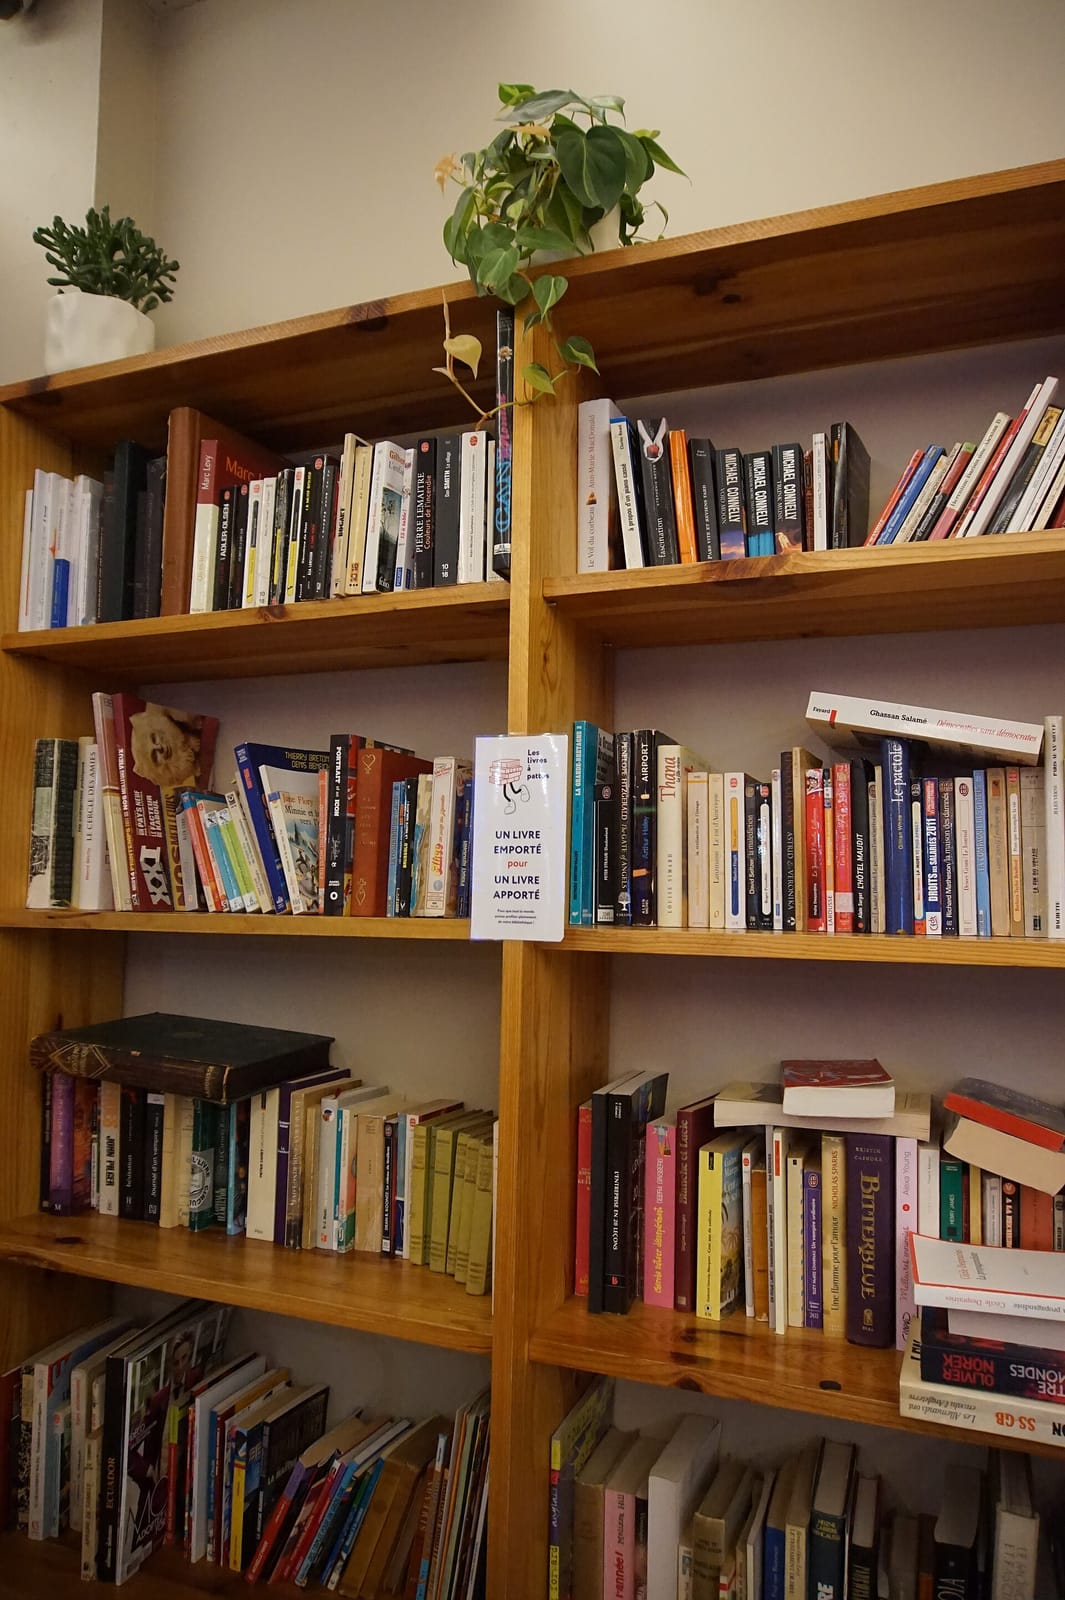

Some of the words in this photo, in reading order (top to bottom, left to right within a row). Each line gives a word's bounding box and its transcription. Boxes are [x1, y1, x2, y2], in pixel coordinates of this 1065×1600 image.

[203, 455, 213, 471] Levy
[725, 454, 737, 485] MICHAEL
[753, 457, 766, 489] MICHAEL
[783, 450, 795, 482] MICHAEL
[202, 472, 210, 489] Marc
[416, 473, 425, 518] LEMAITRE
[727, 487, 740, 522] CONNELLY
[784, 484, 797, 520] CONNELLY
[425, 509, 431, 518] de
[626, 508, 634, 526] propos
[755, 490, 768, 525] CONNELLY
[416, 520, 424, 552] PIERRE
[589, 536, 594, 545] du
[656, 518, 667, 558] fascination
[589, 560, 594, 568] Le
[378, 576, 392, 590] folio
[870, 709, 900, 720] Ghassan
[901, 715, 928, 724] Salamé
[997, 728, 1038, 743] démocrates
[285, 752, 307, 760] THIERRY
[527, 756, 548, 764] livres
[641, 742, 649, 782] AIRPORT
[889, 743, 906, 786] pactole
[527, 773, 550, 781] patts
[659, 757, 676, 801] Thana
[575, 787, 580, 795] LA
[891, 789, 904, 802] Le
[136, 807, 144, 828] PAYS
[147, 795, 156, 830] FACTEUR
[153, 800, 163, 830] KABOUL
[495, 830, 511, 839] UN
[512, 830, 541, 839] LIVRE
[926, 818, 937, 836] 2011
[943, 819, 951, 829] des
[493, 844, 542, 854] EMPORTÉ
[856, 833, 864, 861] MAUDIT
[927, 837, 937, 865] SALARIÉS
[943, 830, 951, 854] maison
[140, 845, 171, 905] XXI
[507, 860, 528, 868] pour
[494, 876, 509, 884] UN
[511, 876, 540, 885] LIVRE
[856, 863, 864, 889] L'HÔTEL
[928, 873, 938, 901] DROITS
[493, 889, 540, 900] APPORTÉ
[680, 1120, 688, 1148] Lucie
[106, 1136, 115, 1157] JOHN
[680, 1151, 688, 1160] et
[106, 1160, 115, 1186] PILGER
[902, 1151, 911, 1175] Young
[679, 1163, 688, 1204] Blanche
[831, 1176, 839, 1209] NICHOLAS
[902, 1177, 910, 1196] Alexa
[613, 1209, 619, 1217] EN
[831, 1216, 840, 1244] l'amour
[858, 1172, 880, 1299] BITTERBLUE
[831, 1246, 842, 1263] pour
[831, 1264, 840, 1294] flamme
[831, 1296, 840, 1311] Une
[942, 1353, 994, 1372] NOREK
[942, 1368, 995, 1387] OLIVIER
[922, 1405, 961, 1421] Allemands
[963, 1412, 976, 1423] Les
[106, 1457, 116, 1509] ECUADOR
